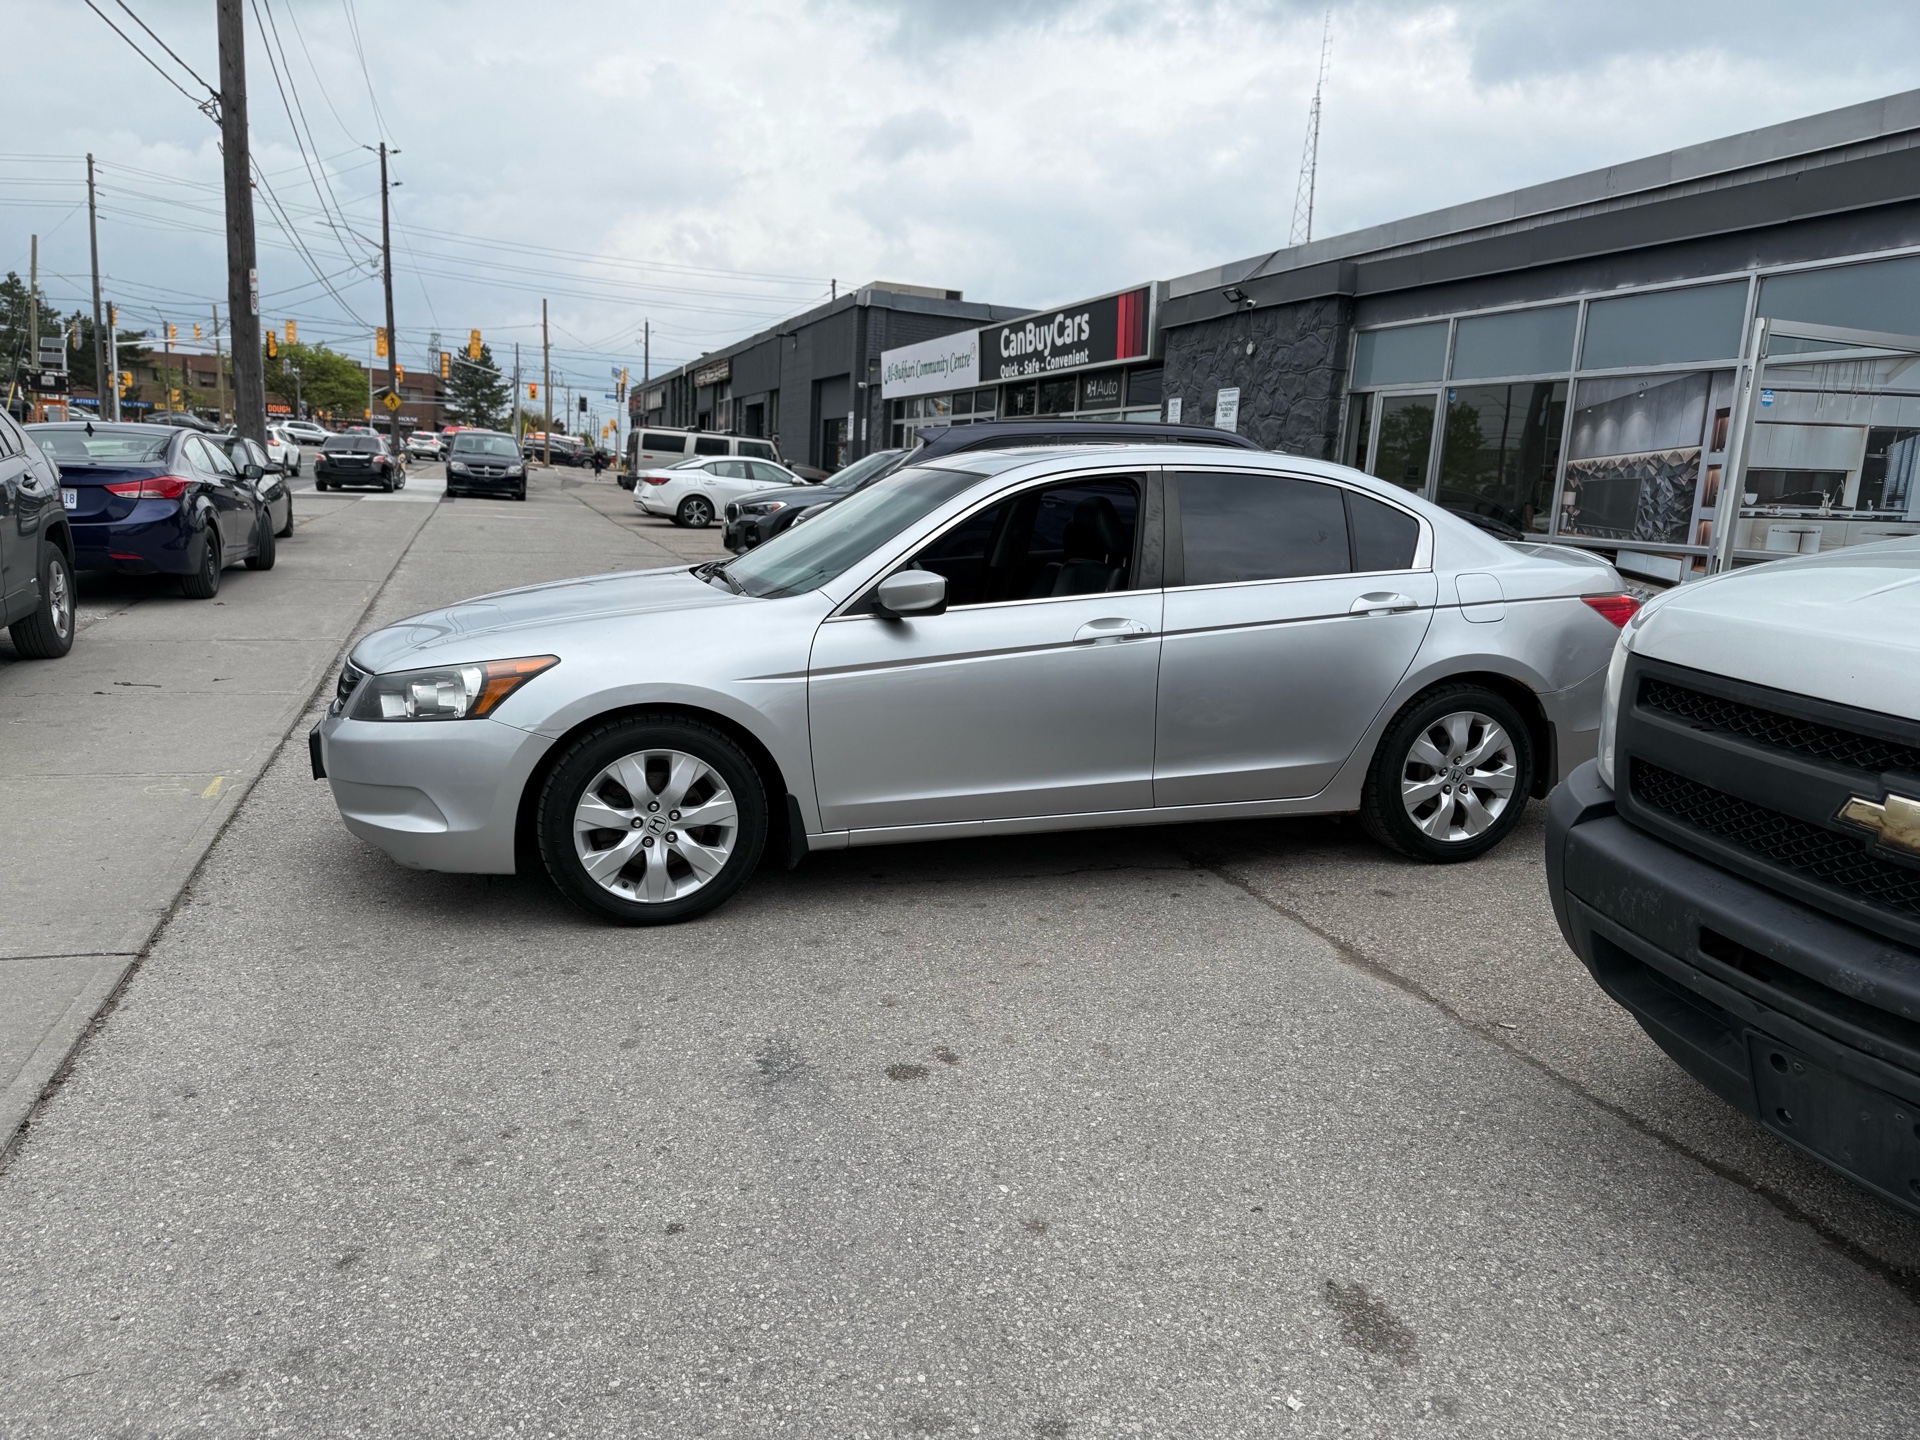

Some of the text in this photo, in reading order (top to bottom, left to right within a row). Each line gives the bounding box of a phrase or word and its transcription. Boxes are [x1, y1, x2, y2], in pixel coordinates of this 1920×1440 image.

[1000, 313, 1090, 358] CanBuyCars
[884, 352, 971, 385] Al-Bukhari Community Centre
[1001, 362, 1019, 379] Quick
[1024, 358, 1040, 374] Safe
[1046, 348, 1089, 370] Convenient
[1097, 379, 1118, 396] Auto
[267, 404, 291, 413] DOUGH
